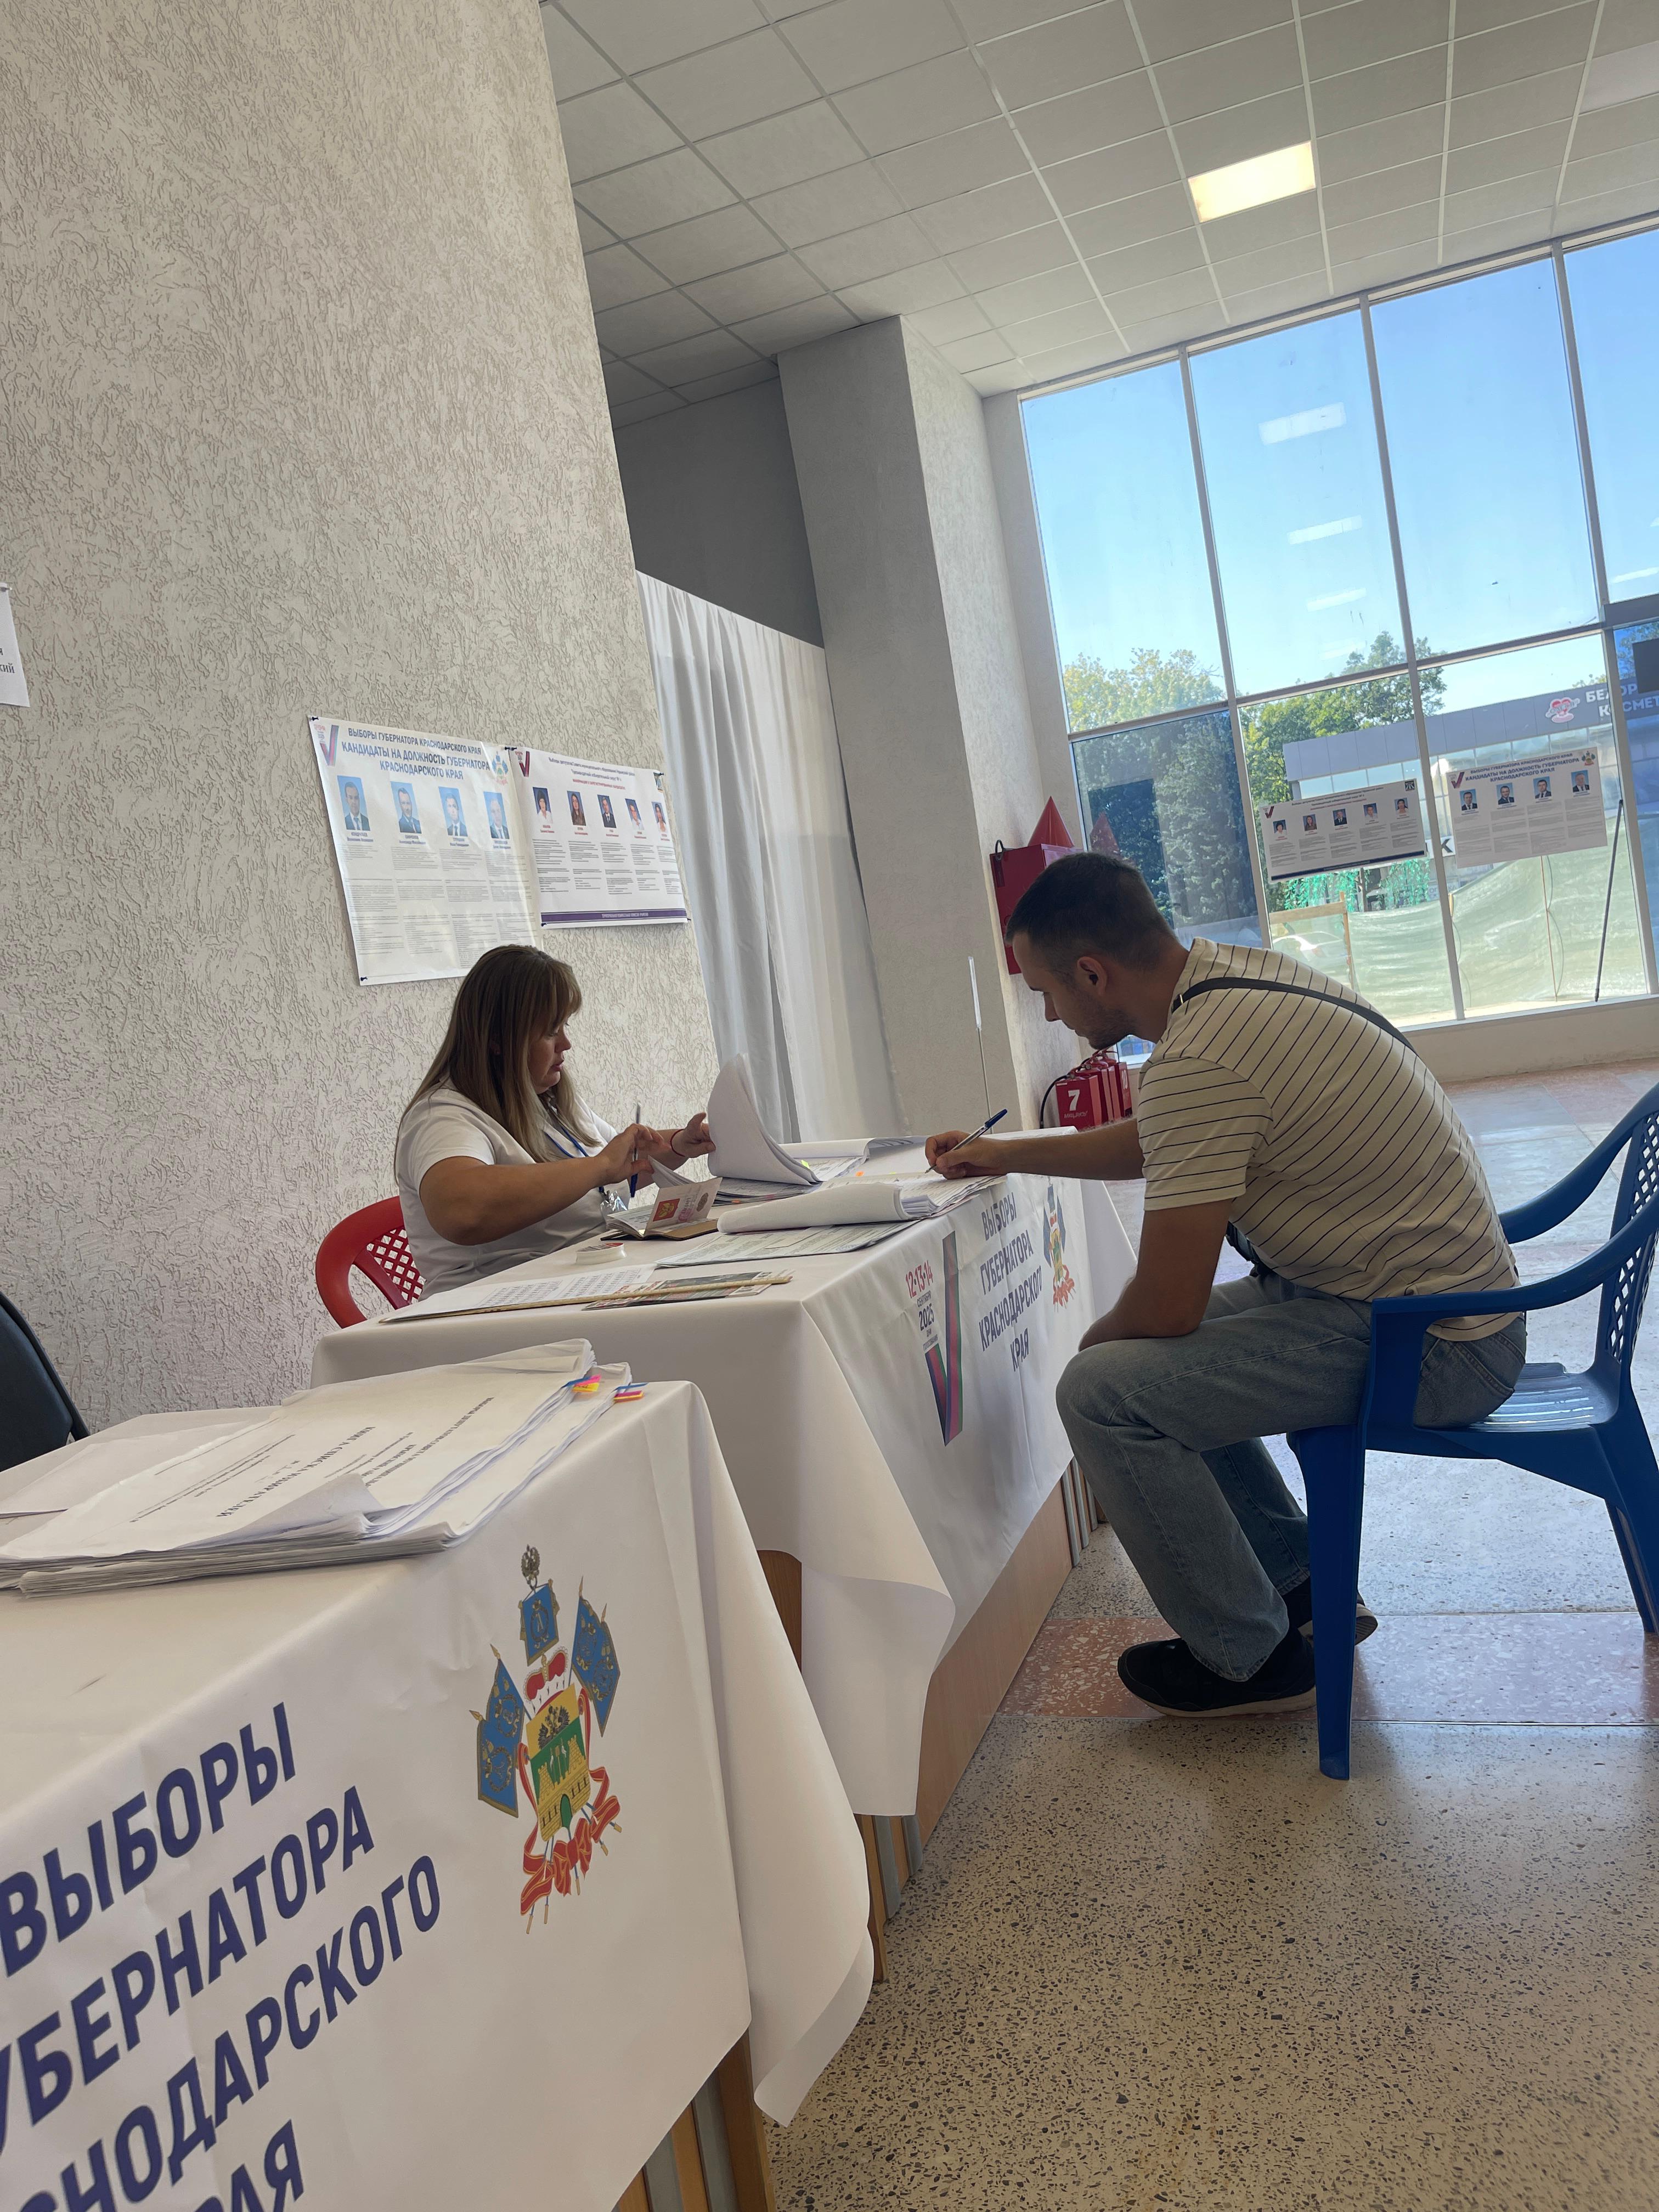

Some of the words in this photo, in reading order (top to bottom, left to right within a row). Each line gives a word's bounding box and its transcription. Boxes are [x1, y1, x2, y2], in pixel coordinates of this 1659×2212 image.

[348, 728, 377, 740] ВЫБОРЫ
[379, 732, 419, 746] ГУБЕРНАТОРА
[420, 738, 466, 753] КРАСНОДАРСКОГО
[467, 746, 481, 755] КРАЯ
[342, 742, 390, 758] КАНДИДАТЫ
[392, 749, 402, 759] НА
[403, 750, 445, 765] ДОЛЖНОСТЬ
[447, 756, 490, 771] ГУБЕРНАТОРА
[380, 761, 444, 777] КРАСНОДАРСКОГО
[446, 769, 464, 780] КРАЯ
[1465, 772, 1498, 781] КАНДИДАТЫ
[1508, 765, 1541, 775] ДОЛЖНОСТЬ
[1542, 758, 1579, 769] ГУБЕРНАТОРА
[1490, 770, 1539, 782] КРАСНОДАРСКОГО
[1068, 1089, 1080, 1111] 7
[981, 1192, 1017, 1241] ВЫБОРЫ
[980, 1229, 1034, 1295] ГУБЕРНАТОРА
[918, 1303, 934, 1331] 2025
[979, 1265, 1042, 1352] КРАСНОДАРСКОГО
[1010, 1328, 1029, 1372] КРАЯ
[338, 1426, 376, 1446] КНИГА
[296, 1447, 343, 1472] СПИСКА
[0, 1702, 296, 1977] ВЫБОРЫ
[19, 1855, 440, 2212] НОДАРСКОГО
[194, 2119, 304, 2212] АЯ
